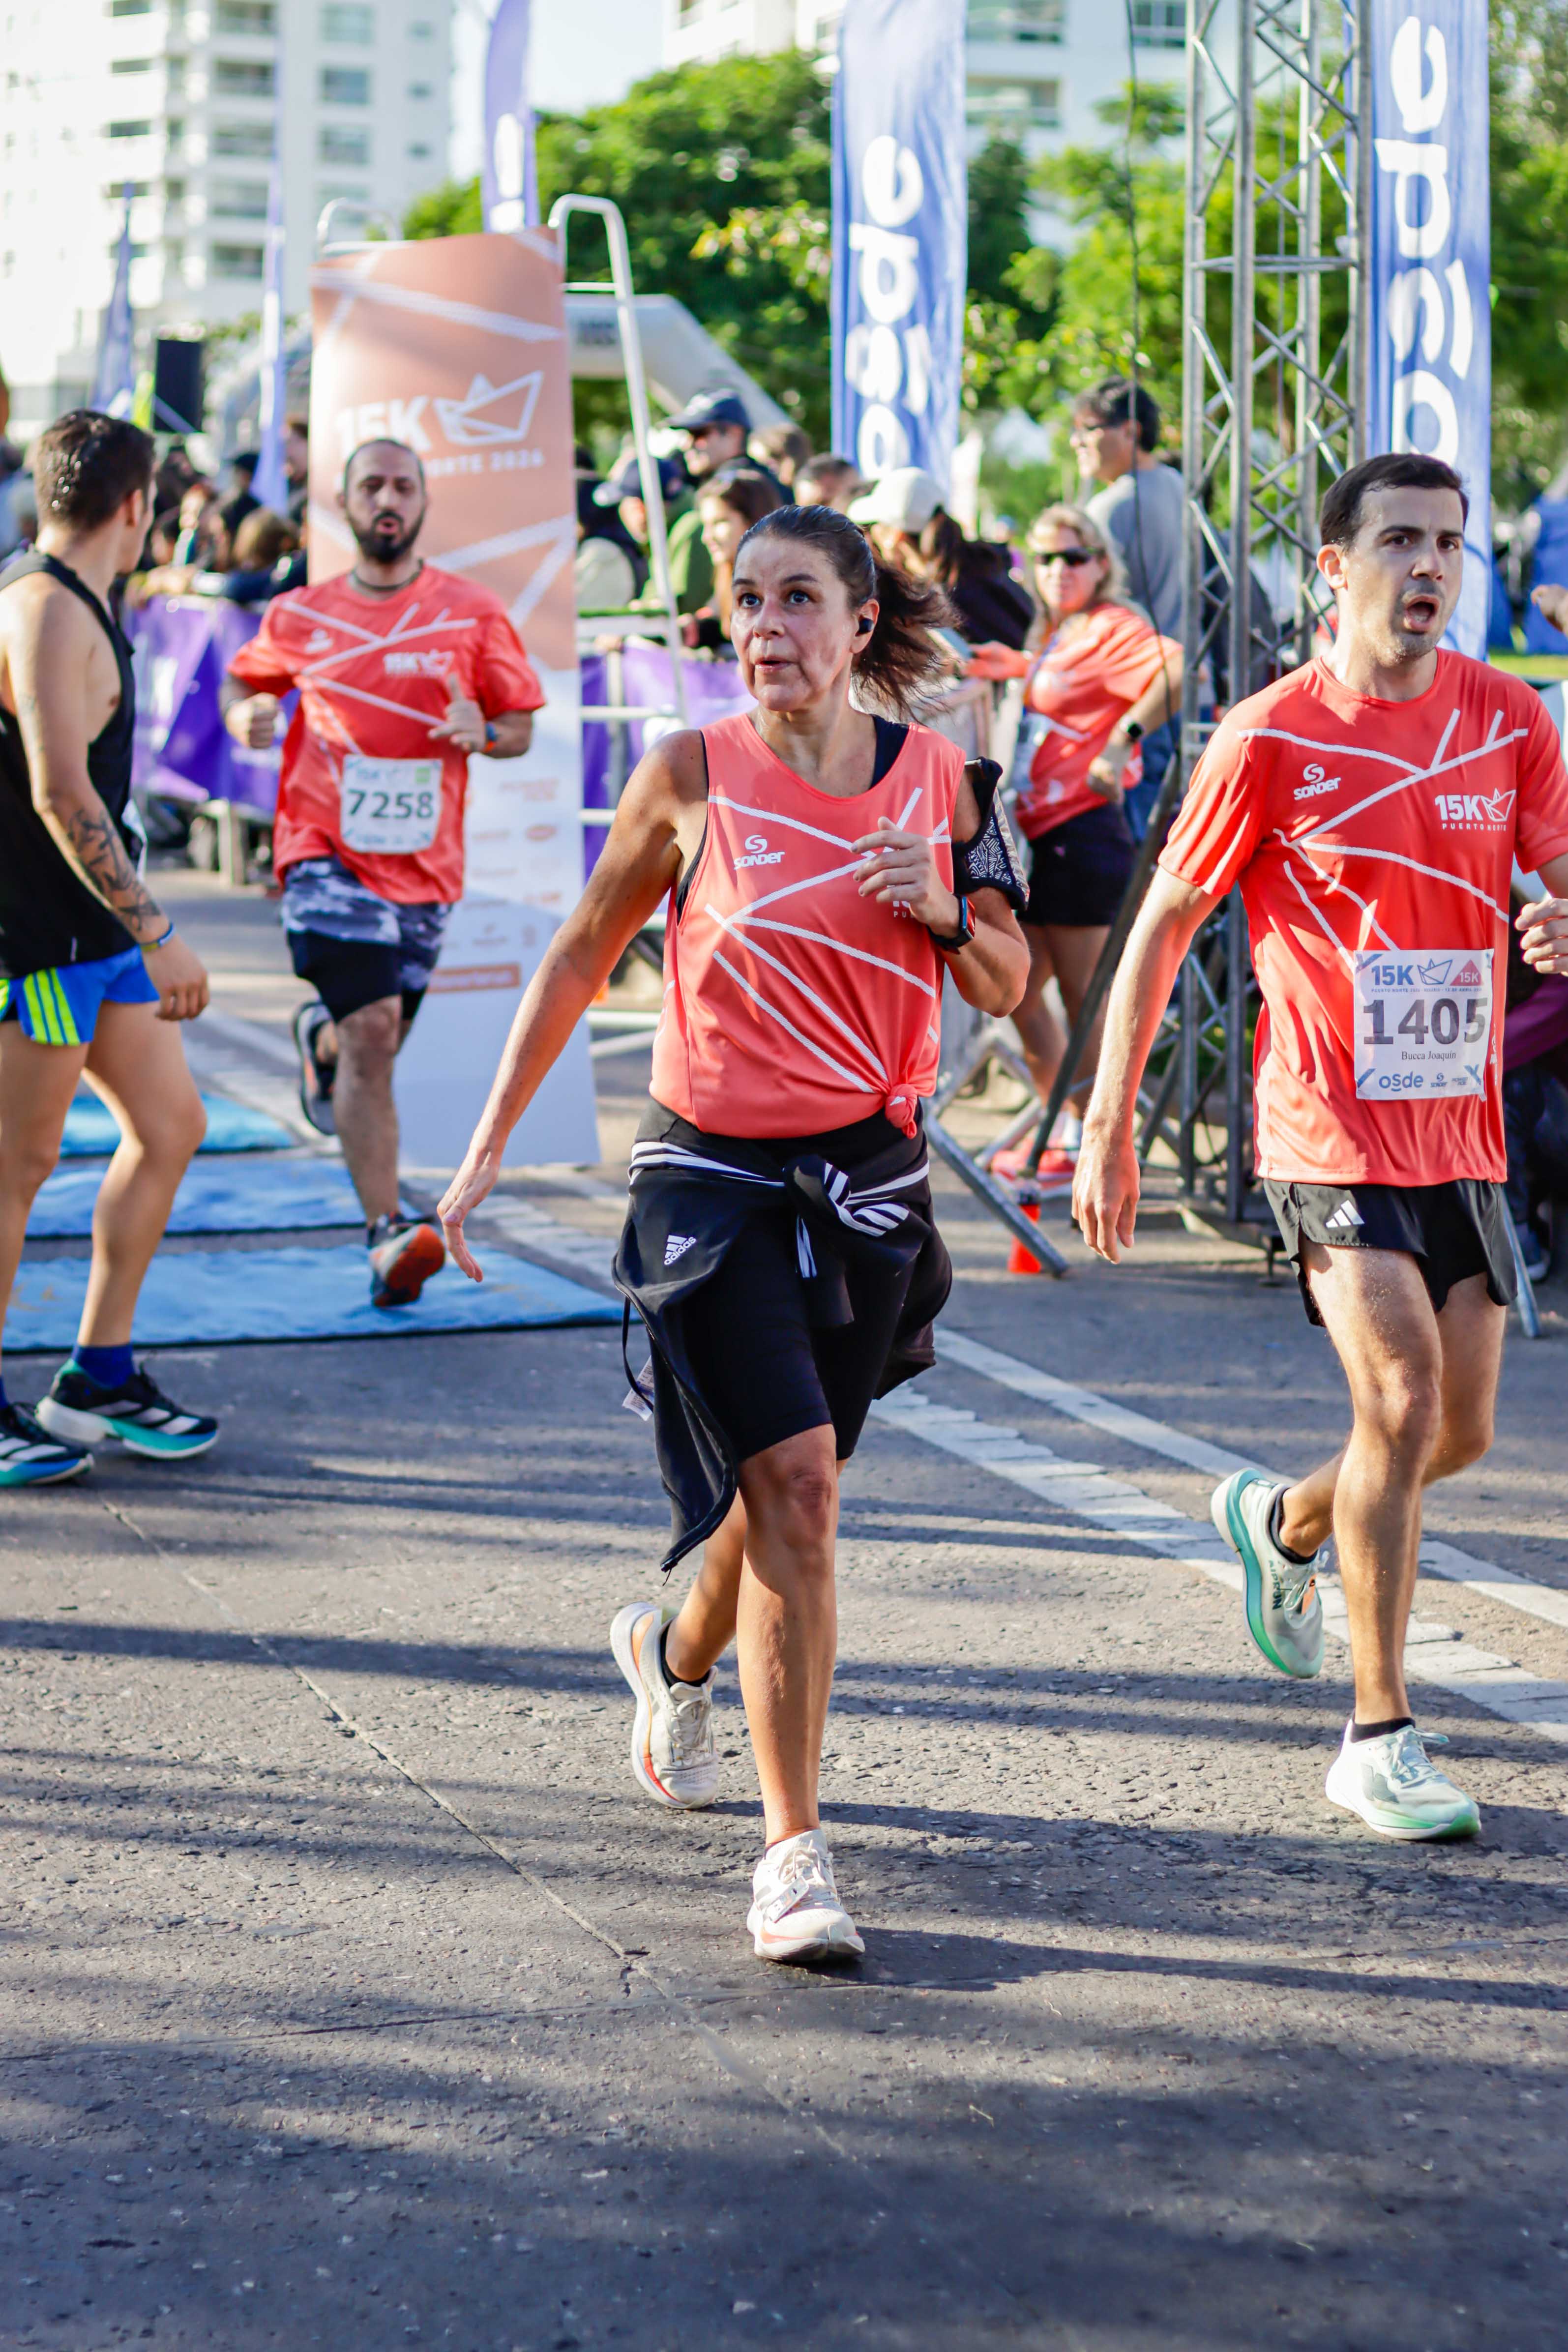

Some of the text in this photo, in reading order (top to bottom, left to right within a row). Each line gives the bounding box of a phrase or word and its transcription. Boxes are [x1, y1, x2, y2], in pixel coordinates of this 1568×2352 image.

[1374, 16, 1472, 467] osde
[845, 135, 932, 481] osde
[347, 788, 433, 819] 7258
[1434, 794, 1483, 821] 15K
[1371, 965, 1479, 985] 15K 15K
[1363, 998, 1487, 1044] 1405
[1401, 1051, 1425, 1059] Bucca
[1379, 1071, 1423, 1091] osde
[664, 1236, 697, 1265] adidas
